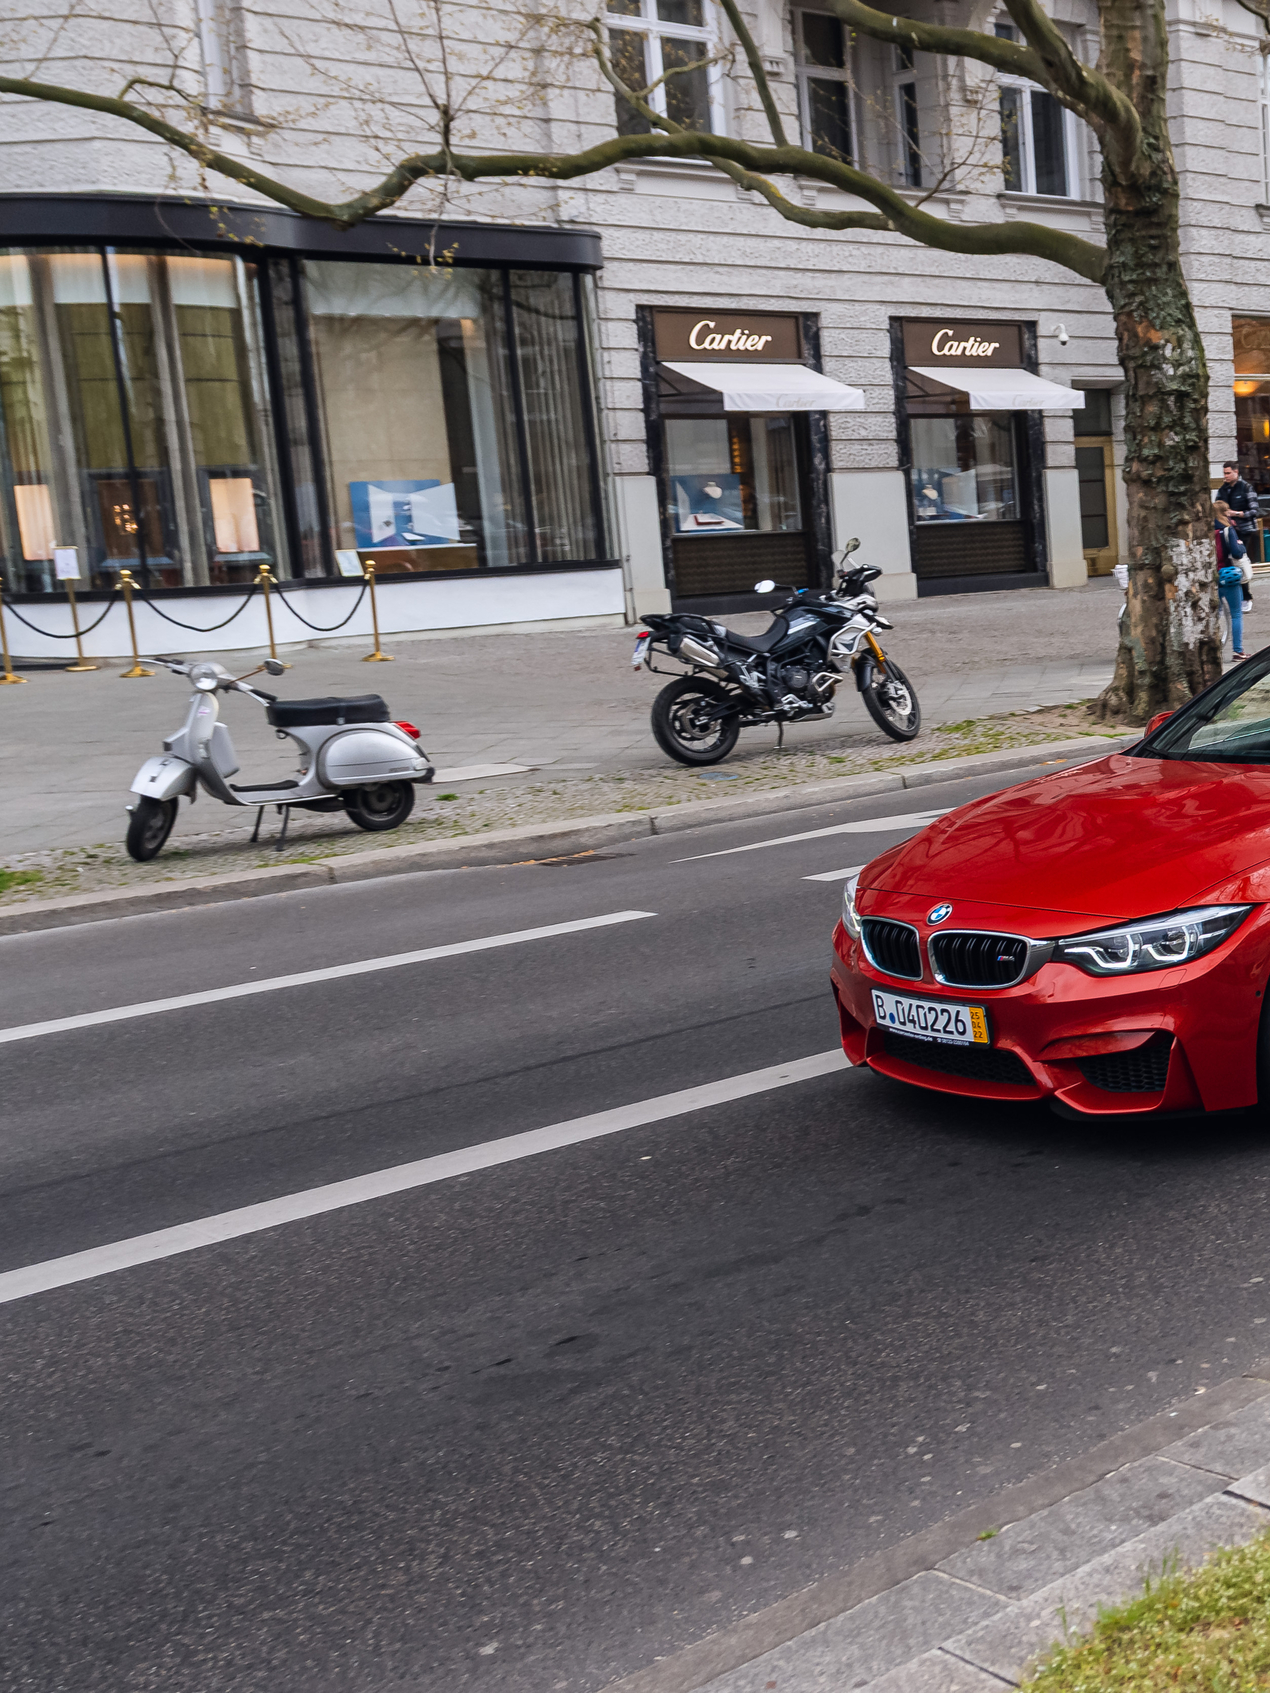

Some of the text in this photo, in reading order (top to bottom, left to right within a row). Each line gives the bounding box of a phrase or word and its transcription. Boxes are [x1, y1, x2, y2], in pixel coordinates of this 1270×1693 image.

[688, 320, 773, 351] Cartier
[931, 328, 1000, 357] Cartier
[895, 1000, 967, 1036] 040226
[970, 1011, 980, 1020] 25
[972, 1021, 982, 1029] 04
[973, 1030, 983, 1039] 22
